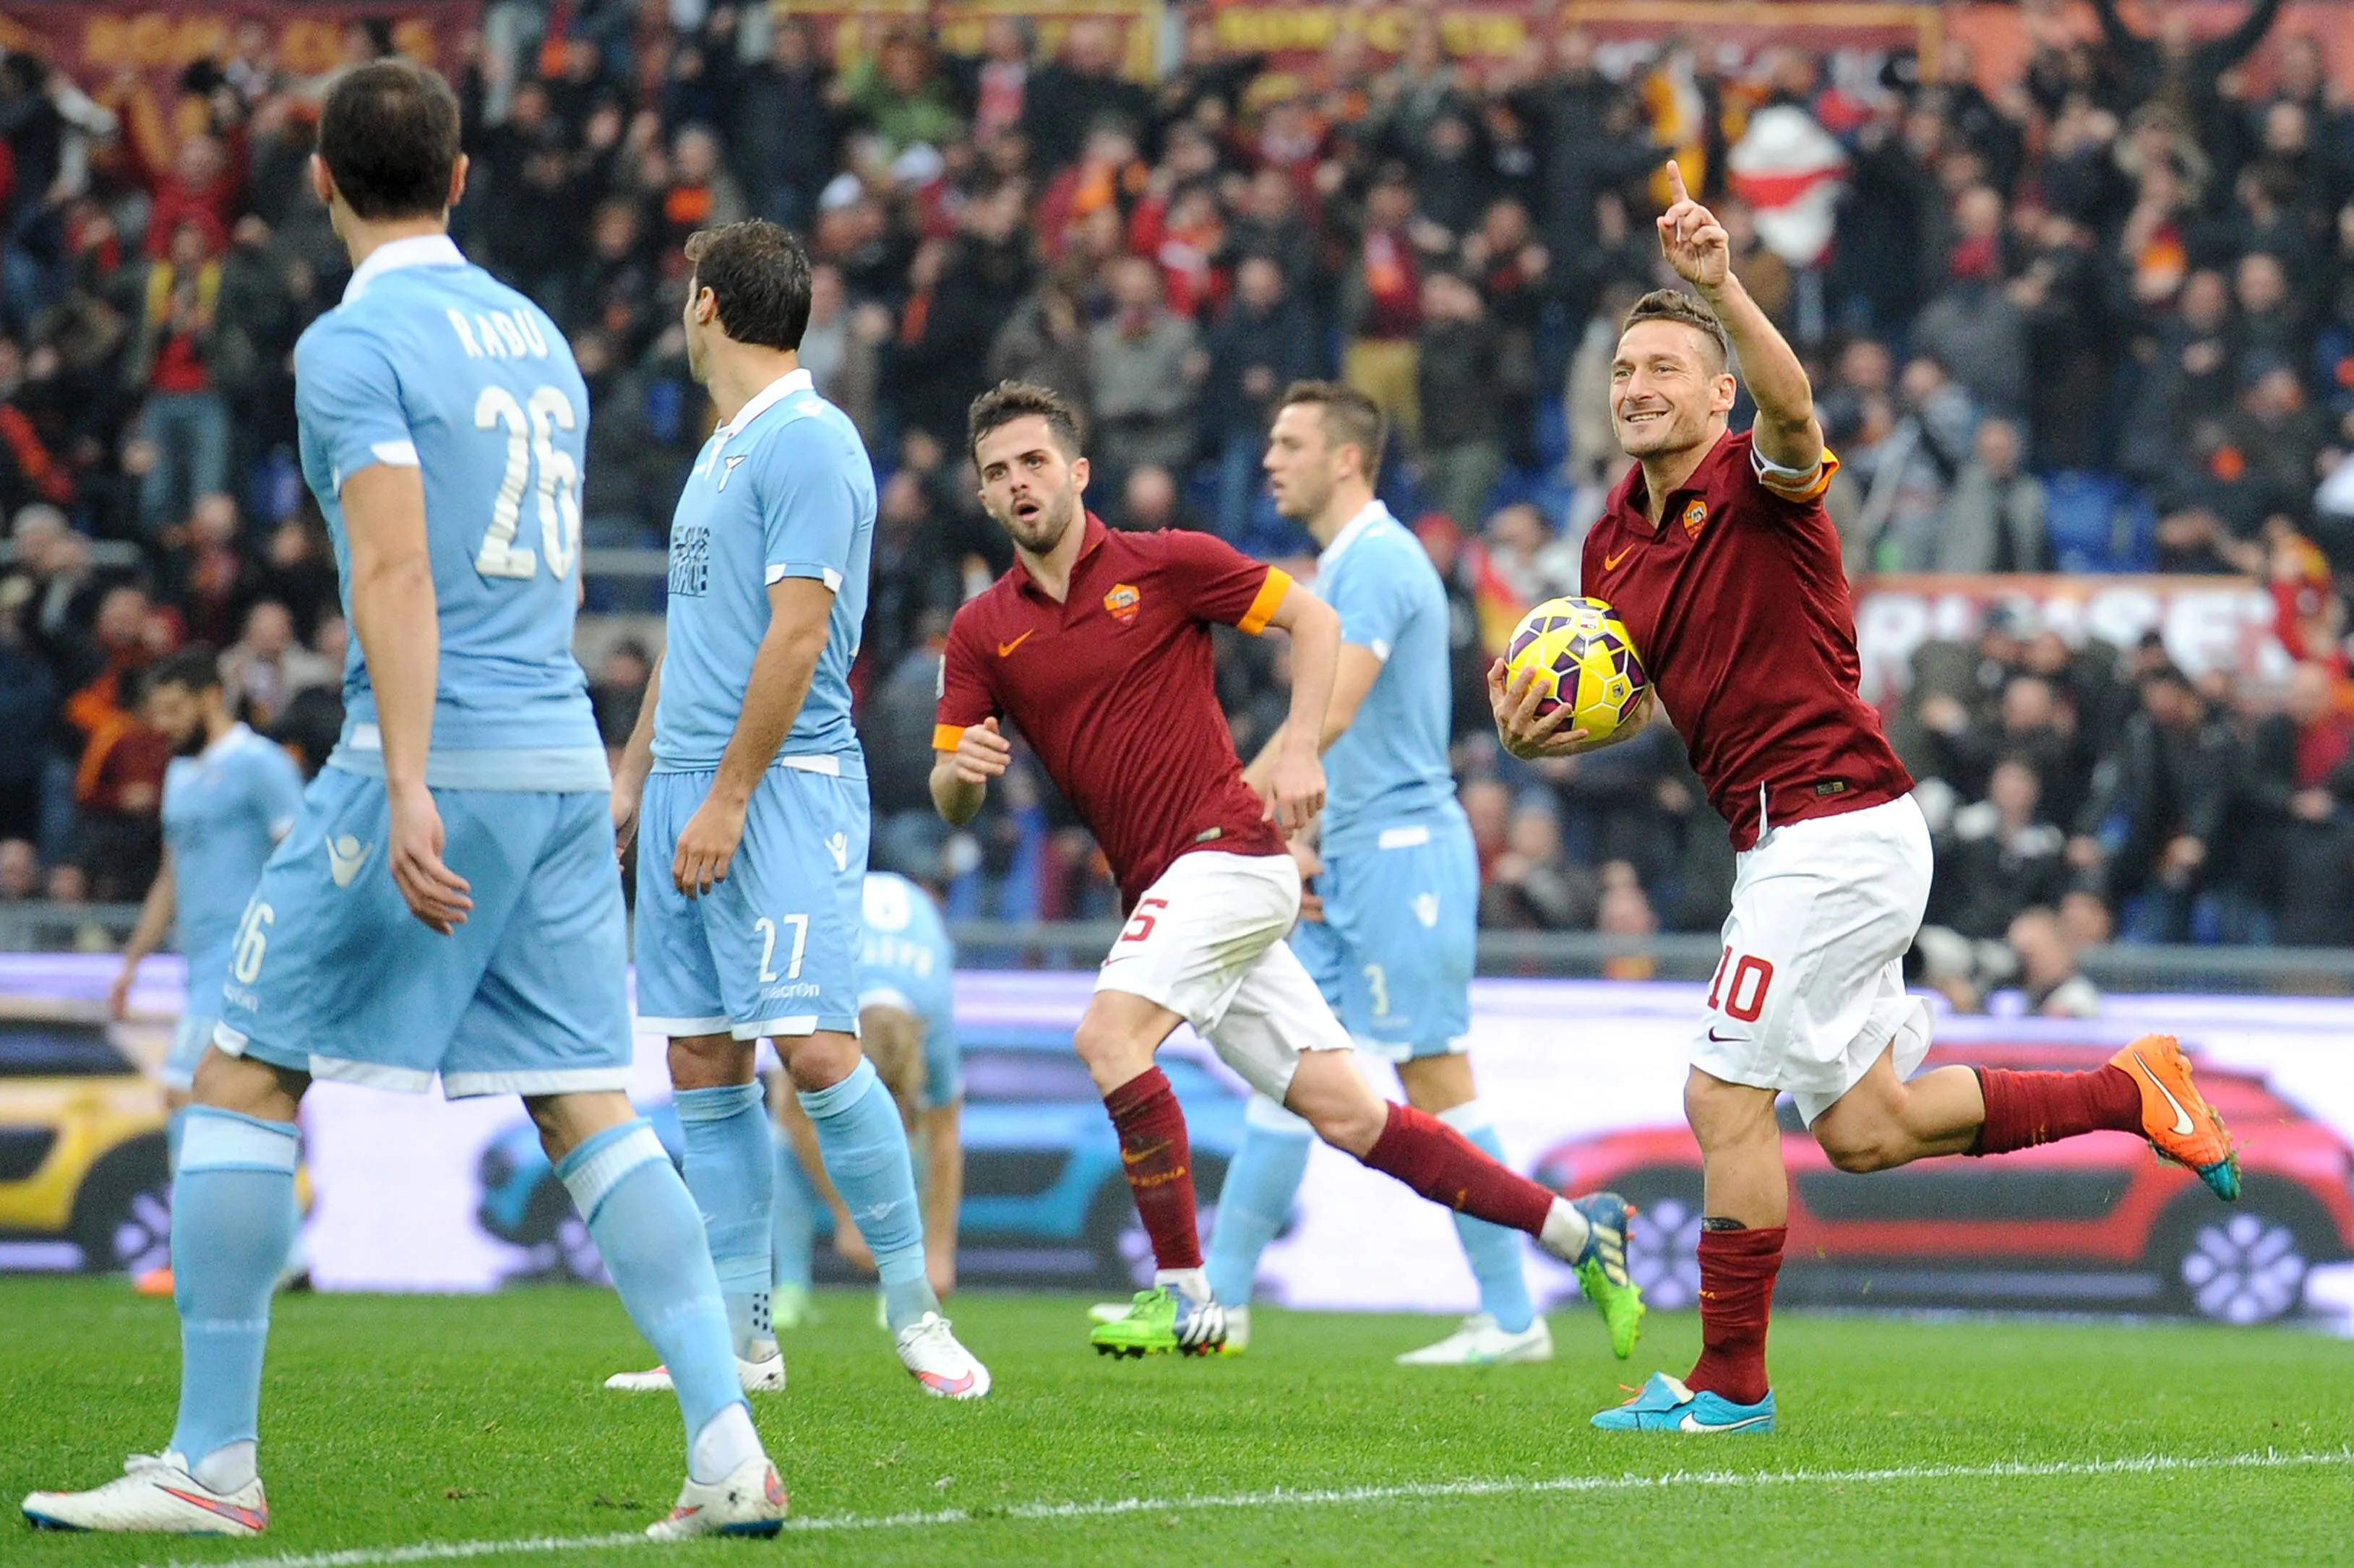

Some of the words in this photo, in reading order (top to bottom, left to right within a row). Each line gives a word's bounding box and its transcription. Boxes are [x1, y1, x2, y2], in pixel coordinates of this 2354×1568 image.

[447, 308, 548, 359] RADU
[474, 384, 580, 582] 26
[754, 913, 809, 983] 27
[1707, 944, 1774, 1023] 10
